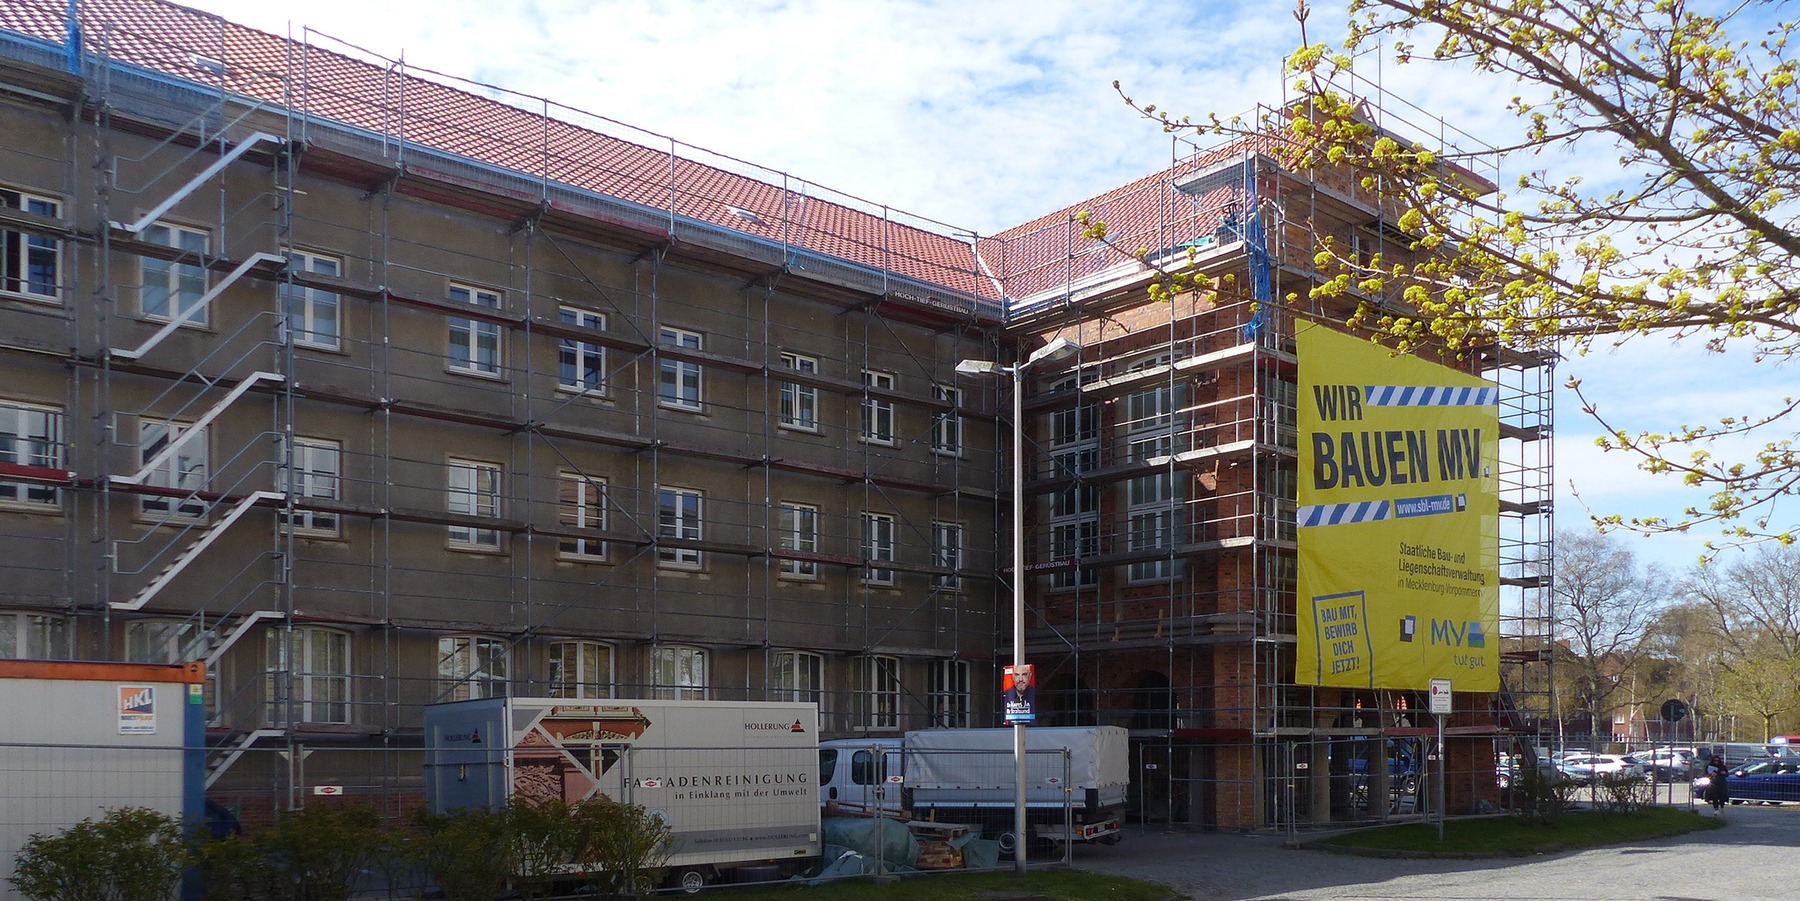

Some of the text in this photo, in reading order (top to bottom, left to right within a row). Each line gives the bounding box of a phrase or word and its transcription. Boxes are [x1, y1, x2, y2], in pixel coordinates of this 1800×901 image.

[1313, 385, 1362, 421] WIR
[1312, 429, 1480, 490] BAUEN MV
[1397, 497, 1450, 515] www.sbl-mv.de
[1399, 542, 1466, 564] Staatliche Bau- und
[1398, 559, 1485, 585] Liegenschaftsverwaltung
[1397, 576, 1483, 597] in Mecklenburg-Vorpommern
[1321, 605, 1357, 622] BAU MIT,
[1324, 622, 1358, 640] BEWIRB
[1431, 618, 1467, 647] MV
[1332, 640, 1354, 656] DICH
[1331, 656, 1360, 675] JETZT!
[1453, 654, 1486, 670] tut gut.
[123, 688, 152, 710] HKL
[744, 722, 790, 731] HOLLERUNG
[675, 787, 807, 800] in Einklang mit der Umwelt
